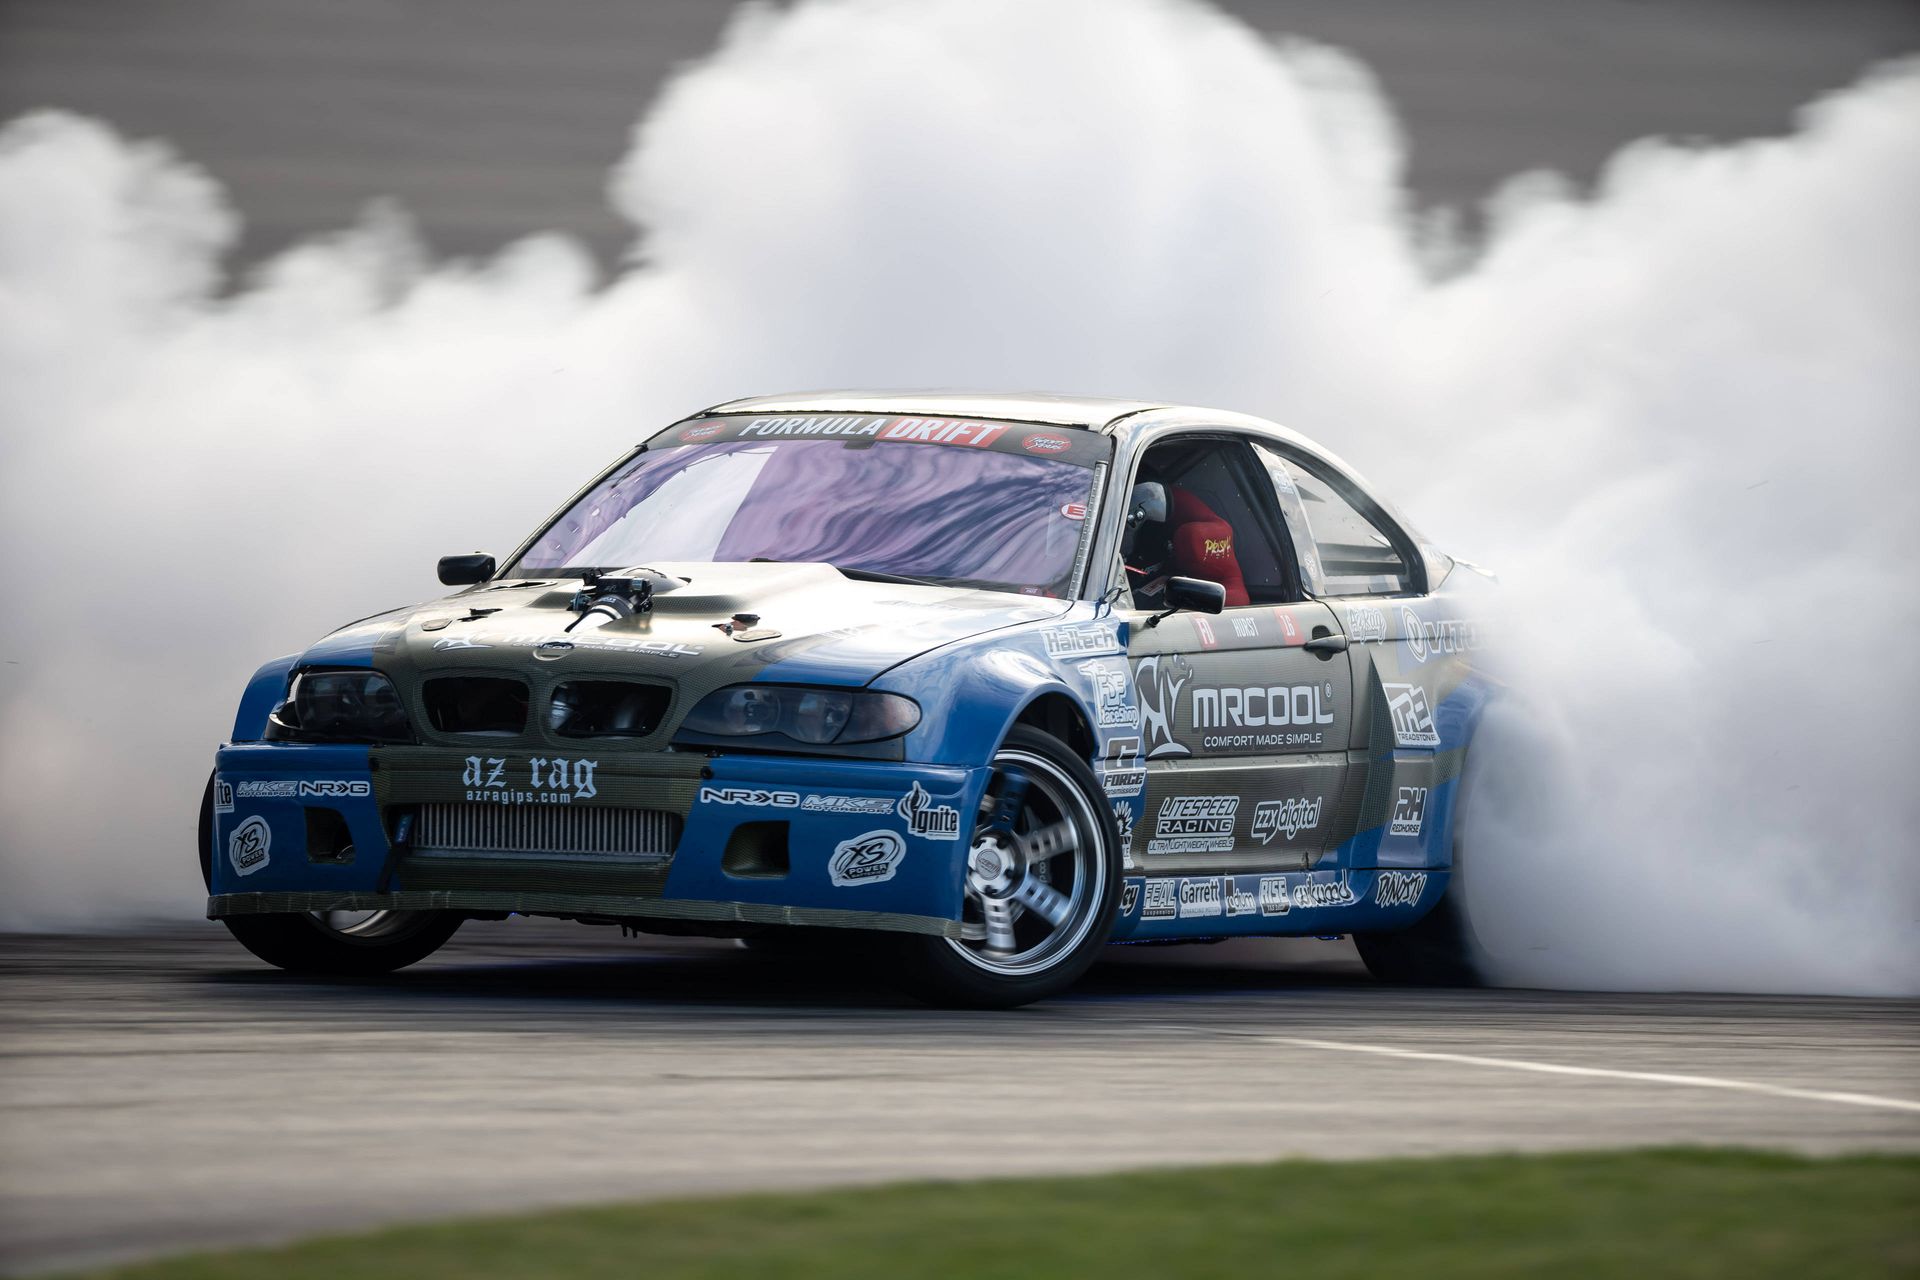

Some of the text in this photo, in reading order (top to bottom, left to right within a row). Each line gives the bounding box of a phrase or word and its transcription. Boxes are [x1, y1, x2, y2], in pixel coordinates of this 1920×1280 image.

[738, 417, 887, 437] FORMULA
[885, 418, 1003, 445] DRIFT
[1045, 629, 1115, 653] Haltech
[1192, 686, 1334, 728] MRCOOL
[1204, 733, 1322, 747] COMFORT MADE SIMPLE
[462, 755, 598, 798] az rag
[1103, 773, 1144, 787] FORCE
[237, 781, 298, 792] MKS
[466, 788, 571, 804] azragips.com
[802, 795, 896, 809] MKS
[801, 805, 895, 814] MOTORSPORT
[1159, 798, 1239, 817] LITESPEED
[1158, 820, 1233, 833] RACING
[1392, 823, 1420, 833] REDHORSE
[1209, 839, 1234, 848] WHEELS
[846, 842, 885, 866] XS
[848, 863, 888, 875] POWER
[1144, 882, 1176, 907] FEAL
[1181, 880, 1219, 904] Garrett
[1260, 880, 1287, 903] RISE
